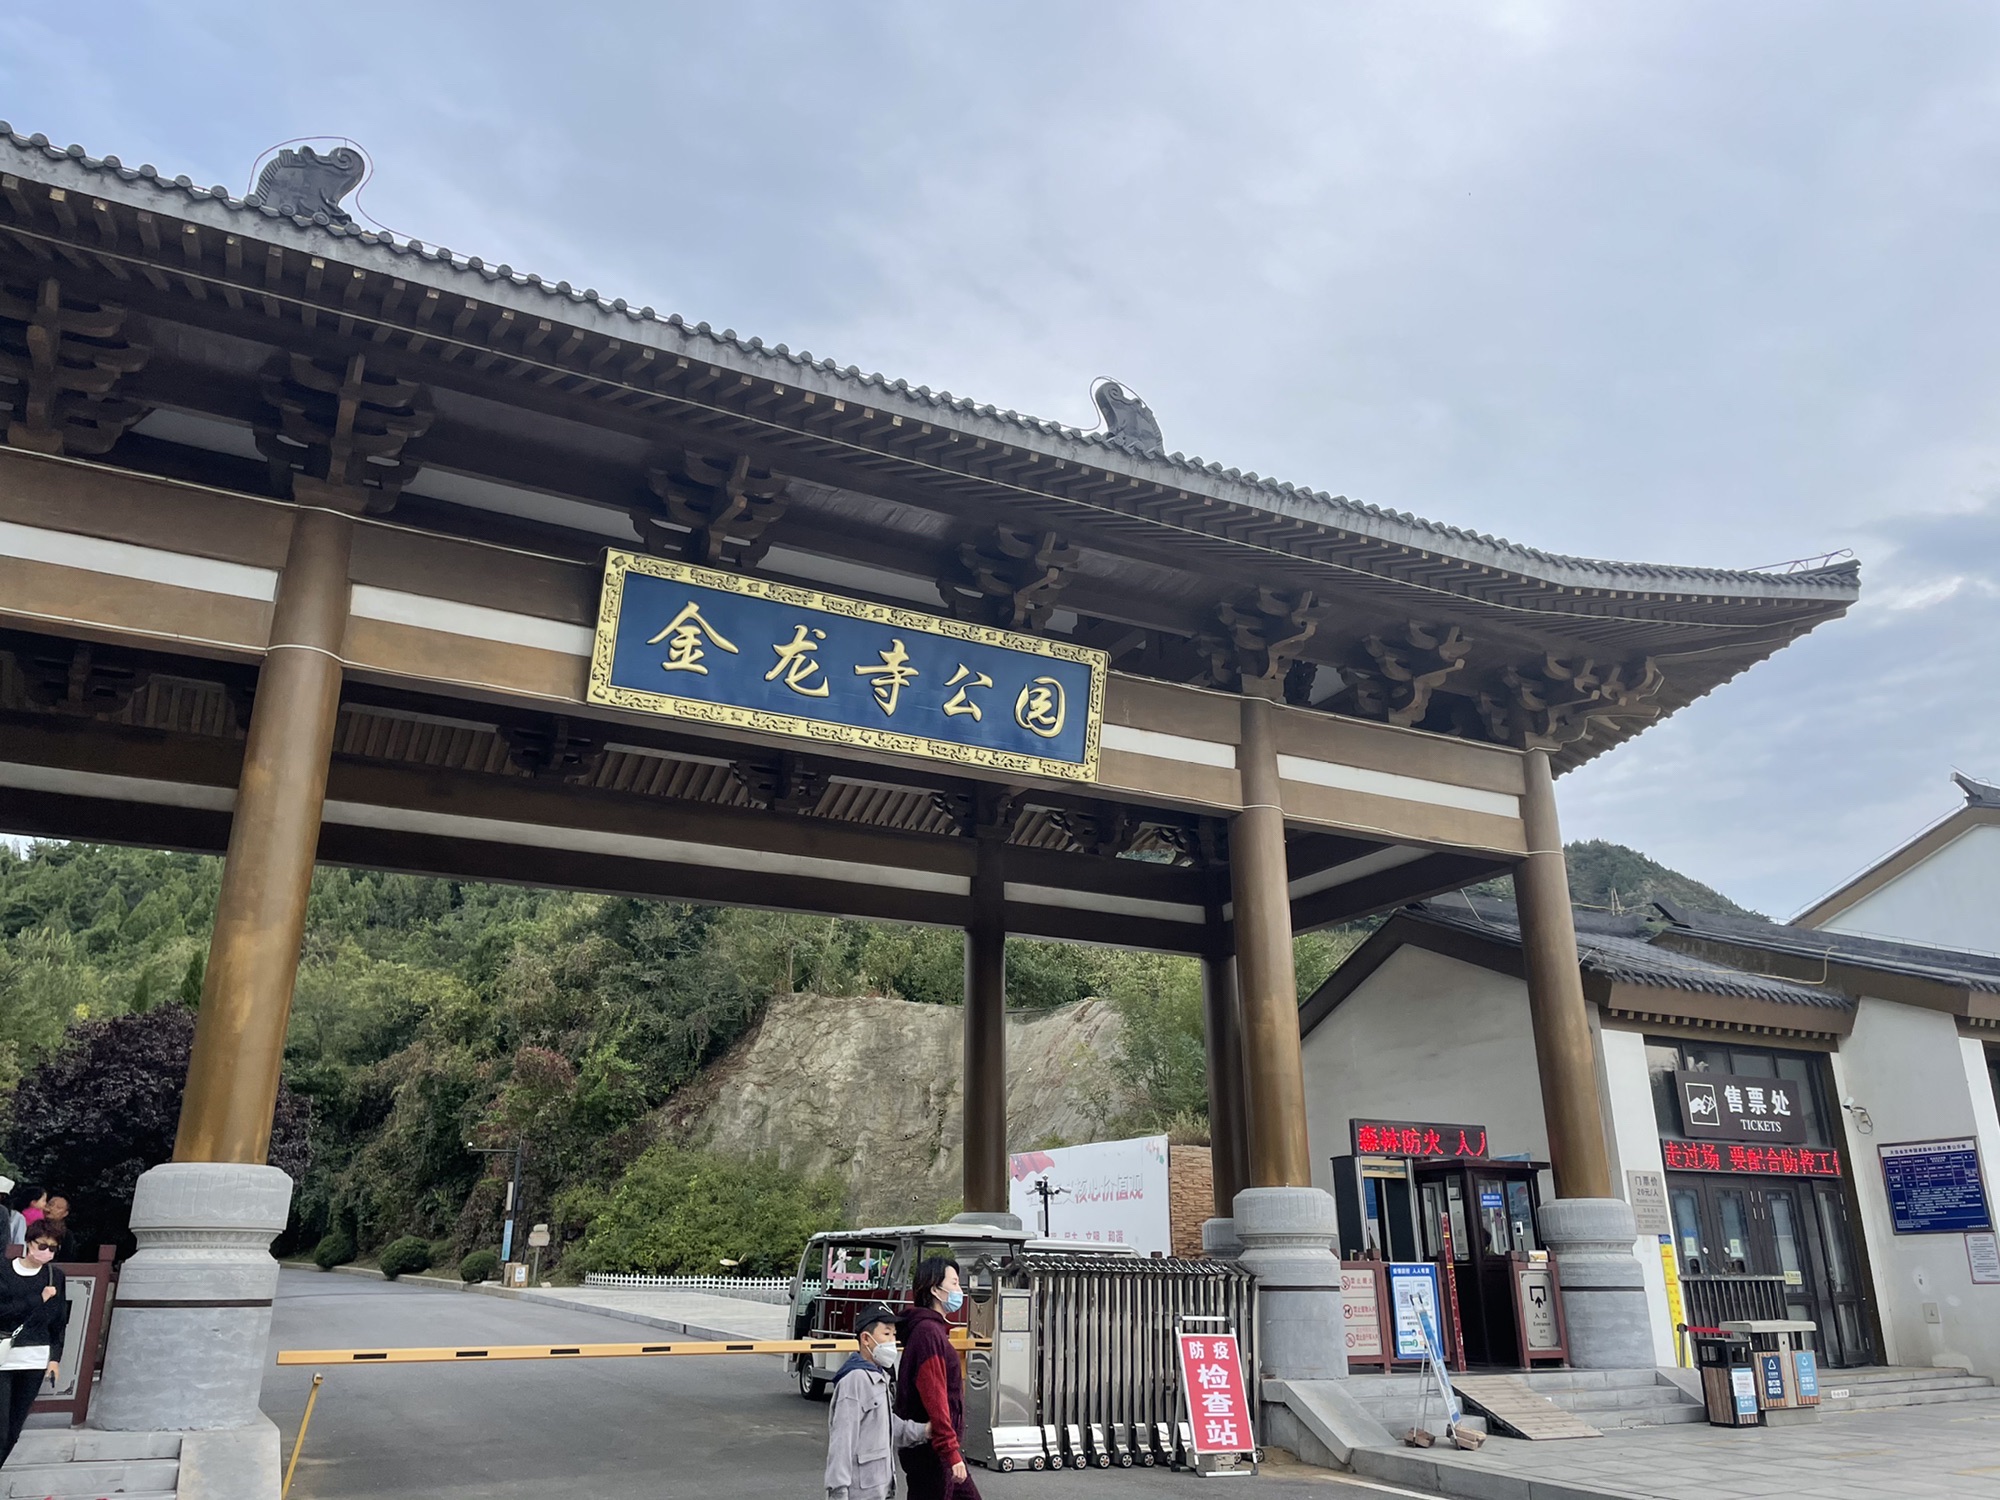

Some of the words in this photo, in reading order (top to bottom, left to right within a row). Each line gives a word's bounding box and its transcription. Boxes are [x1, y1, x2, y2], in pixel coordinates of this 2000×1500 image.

[647, 600, 1066, 739] 金龙寺公园
[1724, 1085, 1791, 1116] 售票处
[1359, 1125, 1444, 1155] 森林防火
[1740, 1119, 1782, 1132] TICKETS
[1666, 1141, 1720, 1171] 走过场
[1635, 1176, 1657, 1186] 门票价
[1637, 1188, 1659, 1197] 20元/人
[1189, 1341, 1230, 1360] 防疫
[1197, 1363, 1239, 1446] 检查站
